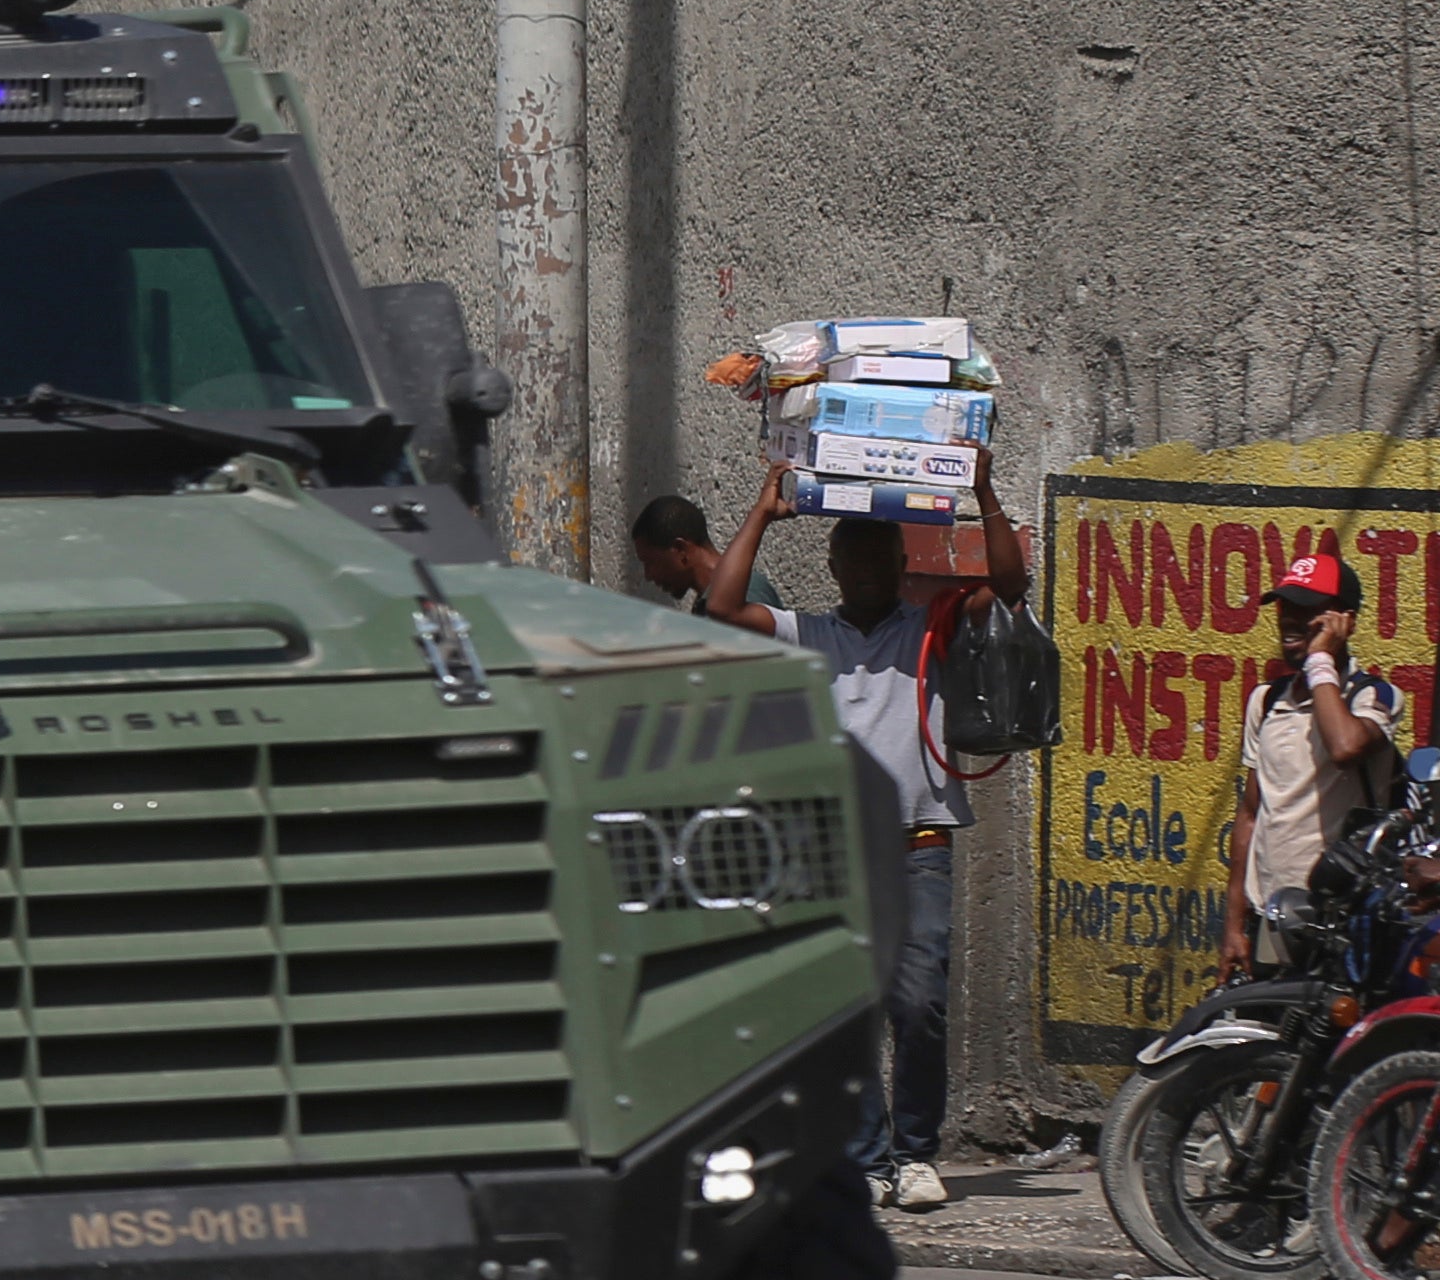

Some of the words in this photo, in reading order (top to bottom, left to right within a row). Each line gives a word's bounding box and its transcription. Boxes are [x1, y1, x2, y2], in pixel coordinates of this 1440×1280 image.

[926, 458, 966, 477] NINA
[32, 705, 285, 736] ROSHEL
[1084, 769, 1188, 865] Ecole
[1054, 876, 1228, 954] PROFESSION
